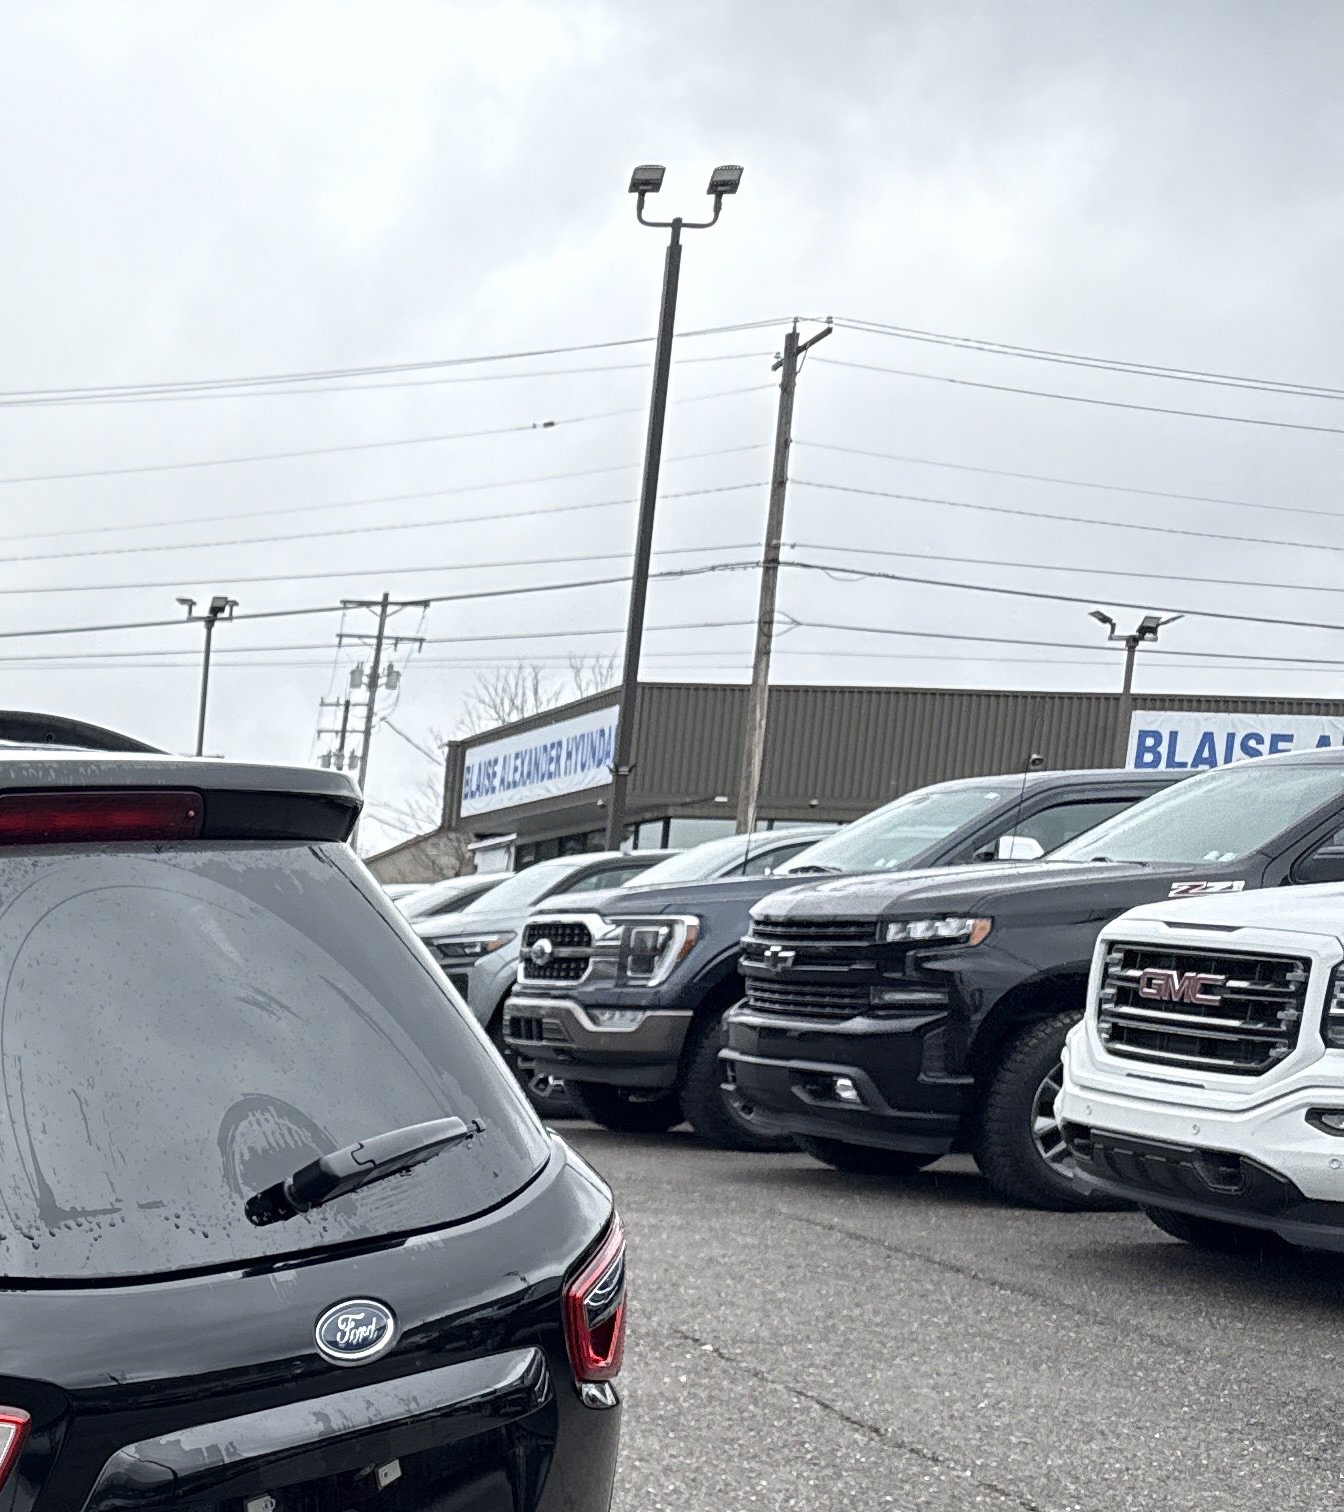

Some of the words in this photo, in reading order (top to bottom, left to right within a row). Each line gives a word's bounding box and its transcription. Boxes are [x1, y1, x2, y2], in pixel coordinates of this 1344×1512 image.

[464, 756, 499, 800] BLAISE
[499, 740, 562, 793] ALEXANDER
[563, 726, 616, 777] HYUNDA
[1139, 967, 1226, 1006] GMC
